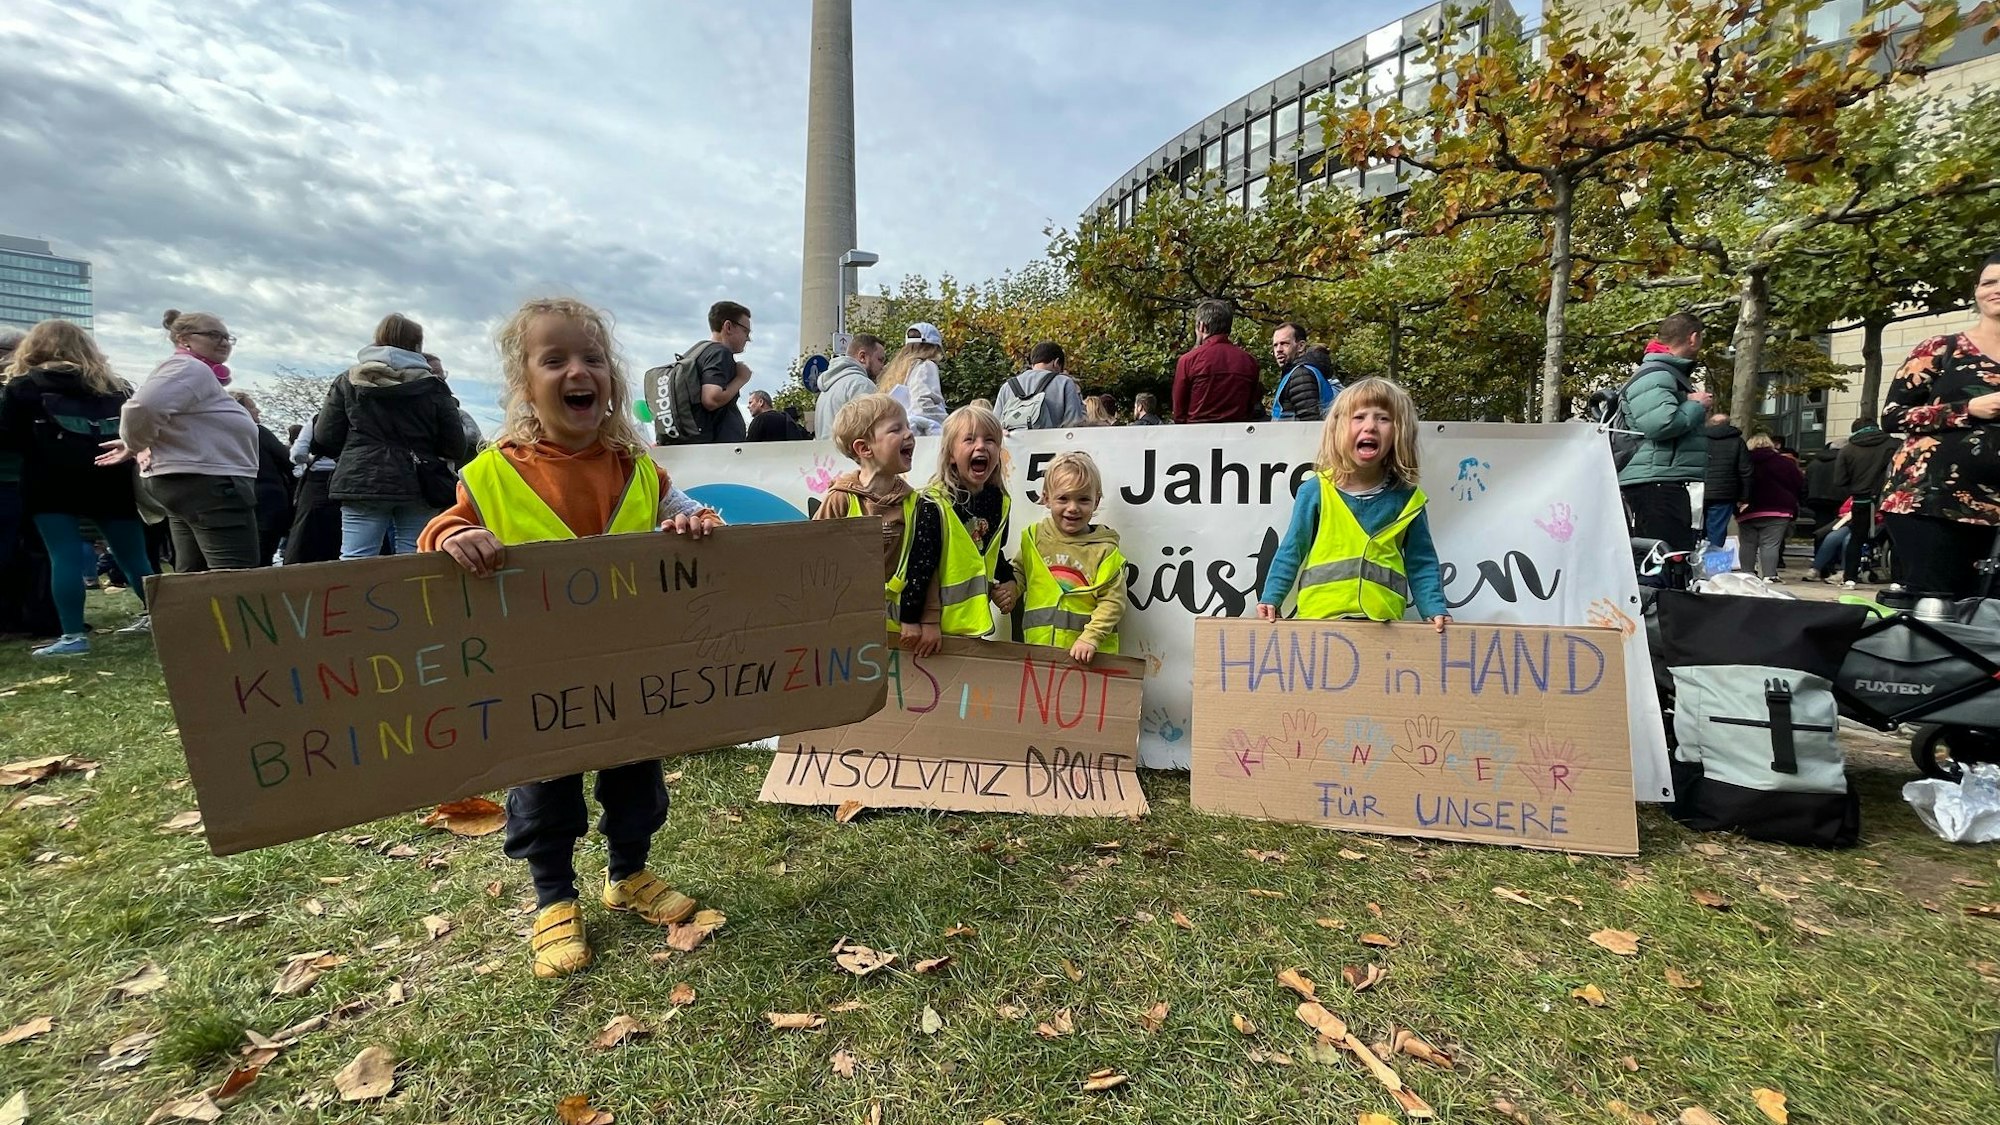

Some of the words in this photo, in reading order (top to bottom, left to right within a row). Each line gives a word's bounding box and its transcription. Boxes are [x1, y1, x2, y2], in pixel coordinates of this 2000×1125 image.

[656, 375, 679, 438] adidas
[210, 561, 638, 653] INVESTITION
[660, 557, 698, 592] IN
[235, 637, 494, 714] KINDER
[1018, 653, 1130, 732] NOT
[1219, 630, 1360, 693] HAND
[1385, 652, 1420, 696] in
[1441, 630, 1605, 697] HAND
[1854, 679, 1921, 695] FUXTEC
[251, 699, 503, 788] BRINGT
[532, 682, 616, 732] DEN
[640, 660, 776, 716] BESTEN
[784, 643, 881, 693] ZINS
[786, 744, 1010, 797] INSOLVENZ
[1025, 745, 1132, 801] DROHT
[1416, 794, 1569, 835] UNSERE
